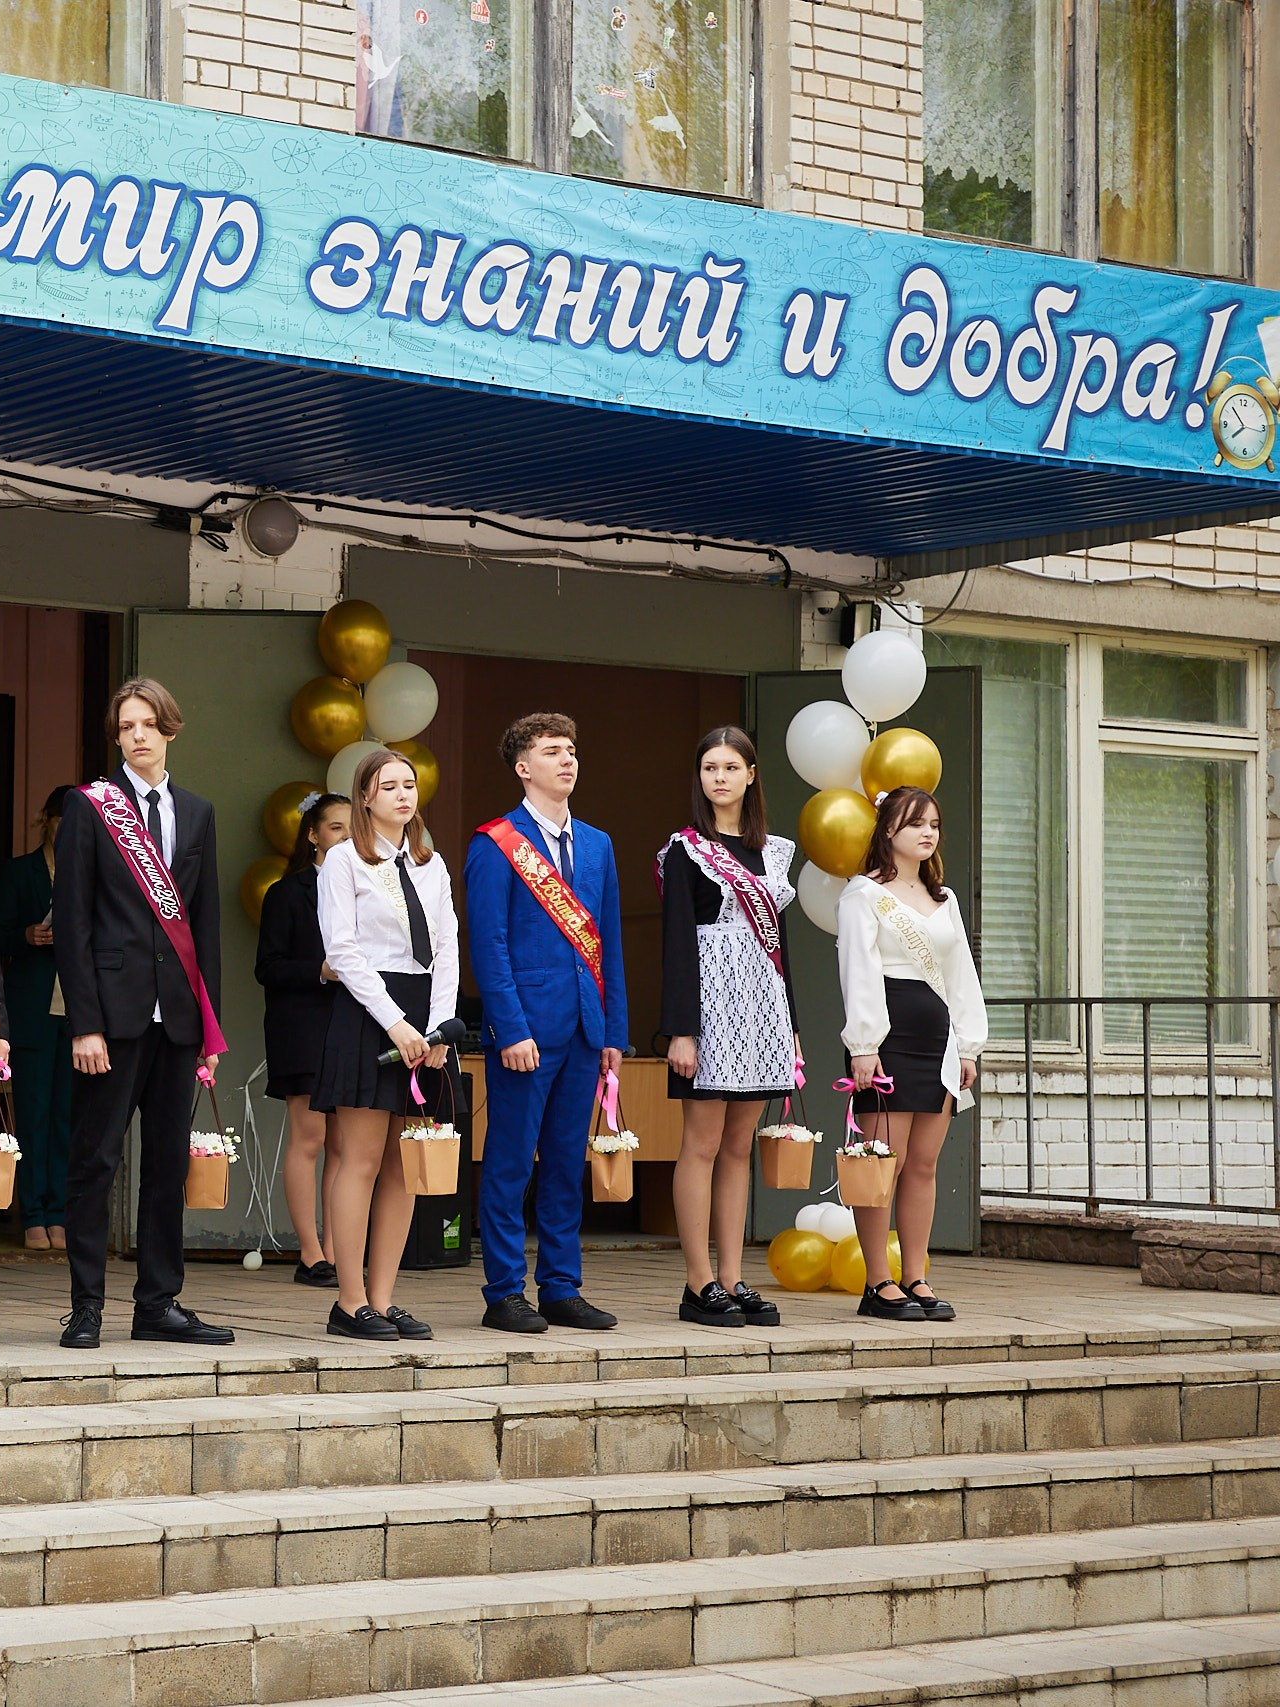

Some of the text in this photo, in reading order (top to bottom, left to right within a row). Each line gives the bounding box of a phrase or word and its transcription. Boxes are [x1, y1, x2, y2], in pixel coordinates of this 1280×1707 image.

[306, 215, 749, 367] знаний
[779, 288, 851, 381] и
[883, 262, 1244, 457] добра!
[1239, 398, 1248, 407] 12
[1223, 420, 1228, 429] 9
[1261, 424, 1266, 432] 3
[1242, 447, 1248, 456] 6
[102, 800, 161, 890] Выпускник
[712, 853, 769, 931] Выпускница
[540, 877, 597, 952] Выпускник
